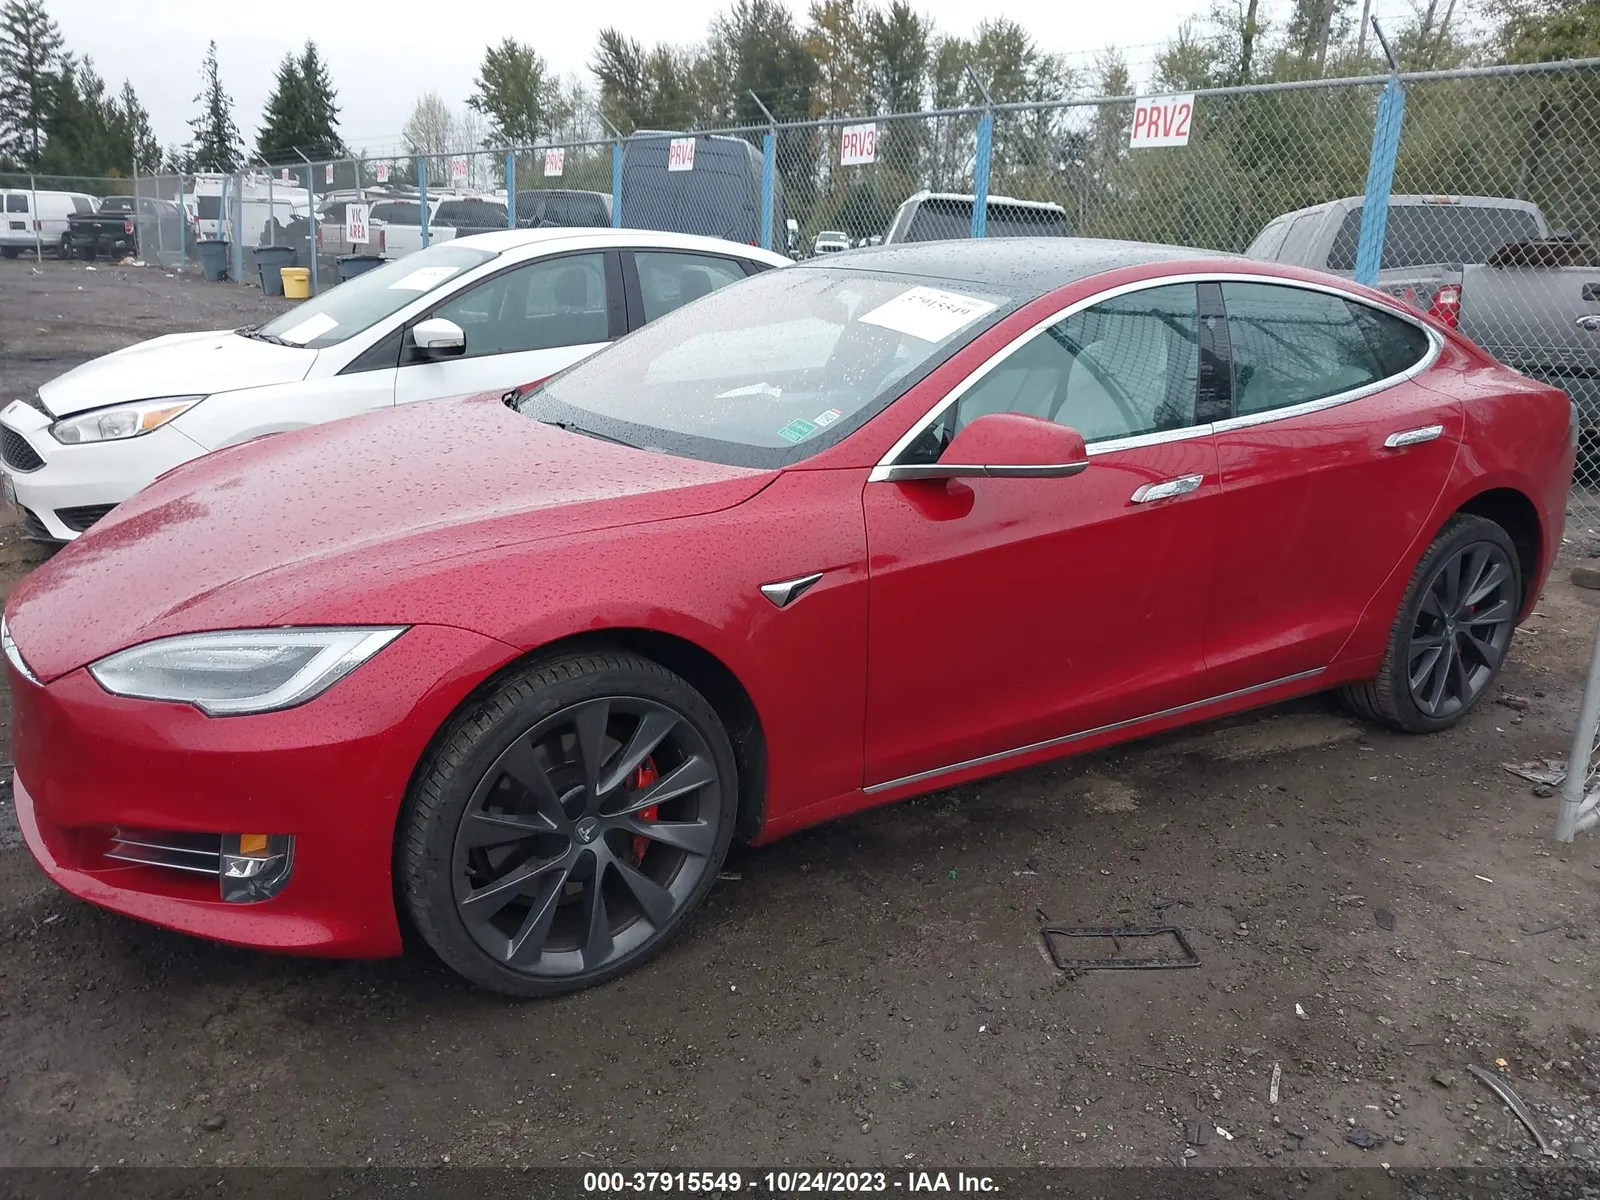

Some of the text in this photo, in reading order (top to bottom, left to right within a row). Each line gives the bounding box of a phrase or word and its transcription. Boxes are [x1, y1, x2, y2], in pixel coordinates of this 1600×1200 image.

[1133, 103, 1191, 139] PRV2
[669, 143, 694, 165] PRV4
[842, 130, 874, 159] PRV3
[351, 207, 362, 222] VIC
[349, 224, 365, 239] AREA
